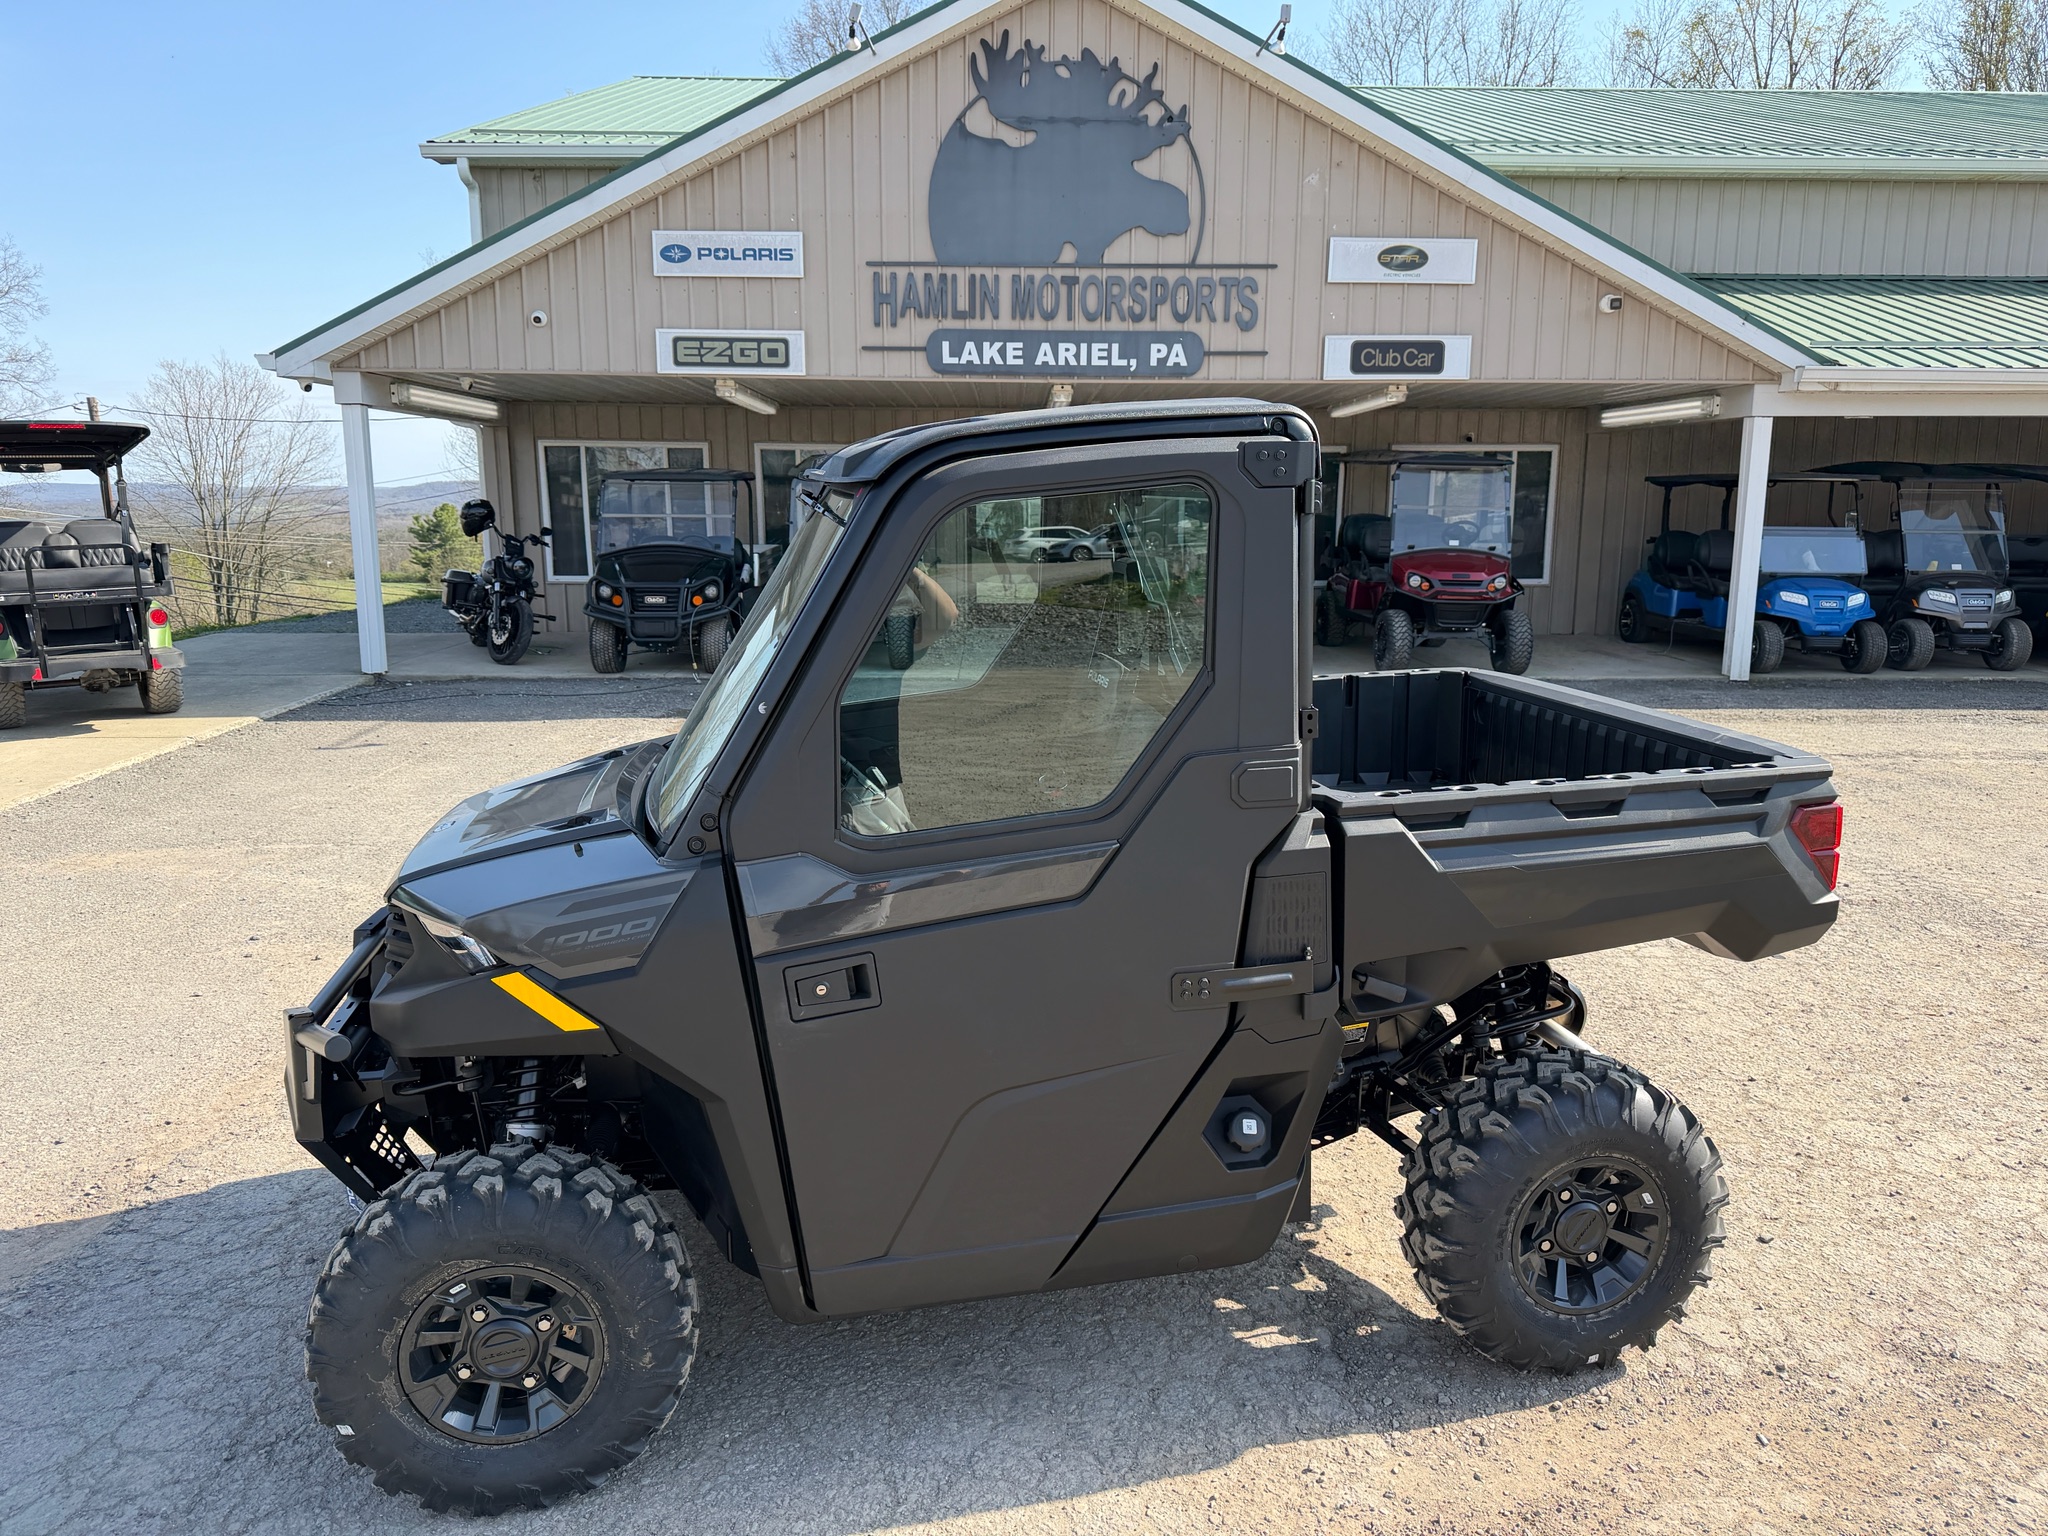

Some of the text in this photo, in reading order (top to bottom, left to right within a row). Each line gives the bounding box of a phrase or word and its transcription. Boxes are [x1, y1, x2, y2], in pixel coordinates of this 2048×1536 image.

[697, 247, 794, 262] POLARIS
[1380, 254, 1420, 264] STAR
[873, 271, 1259, 332] HAMLIN MOTORSPORTS
[941, 341, 1188, 372] LAKE ARIEL, PA
[1360, 348, 1435, 367] Club Car
[1088, 669, 1109, 688] POLARIS
[543, 916, 657, 951] 1000
[496, 1243, 607, 1294] CARLSTAR
